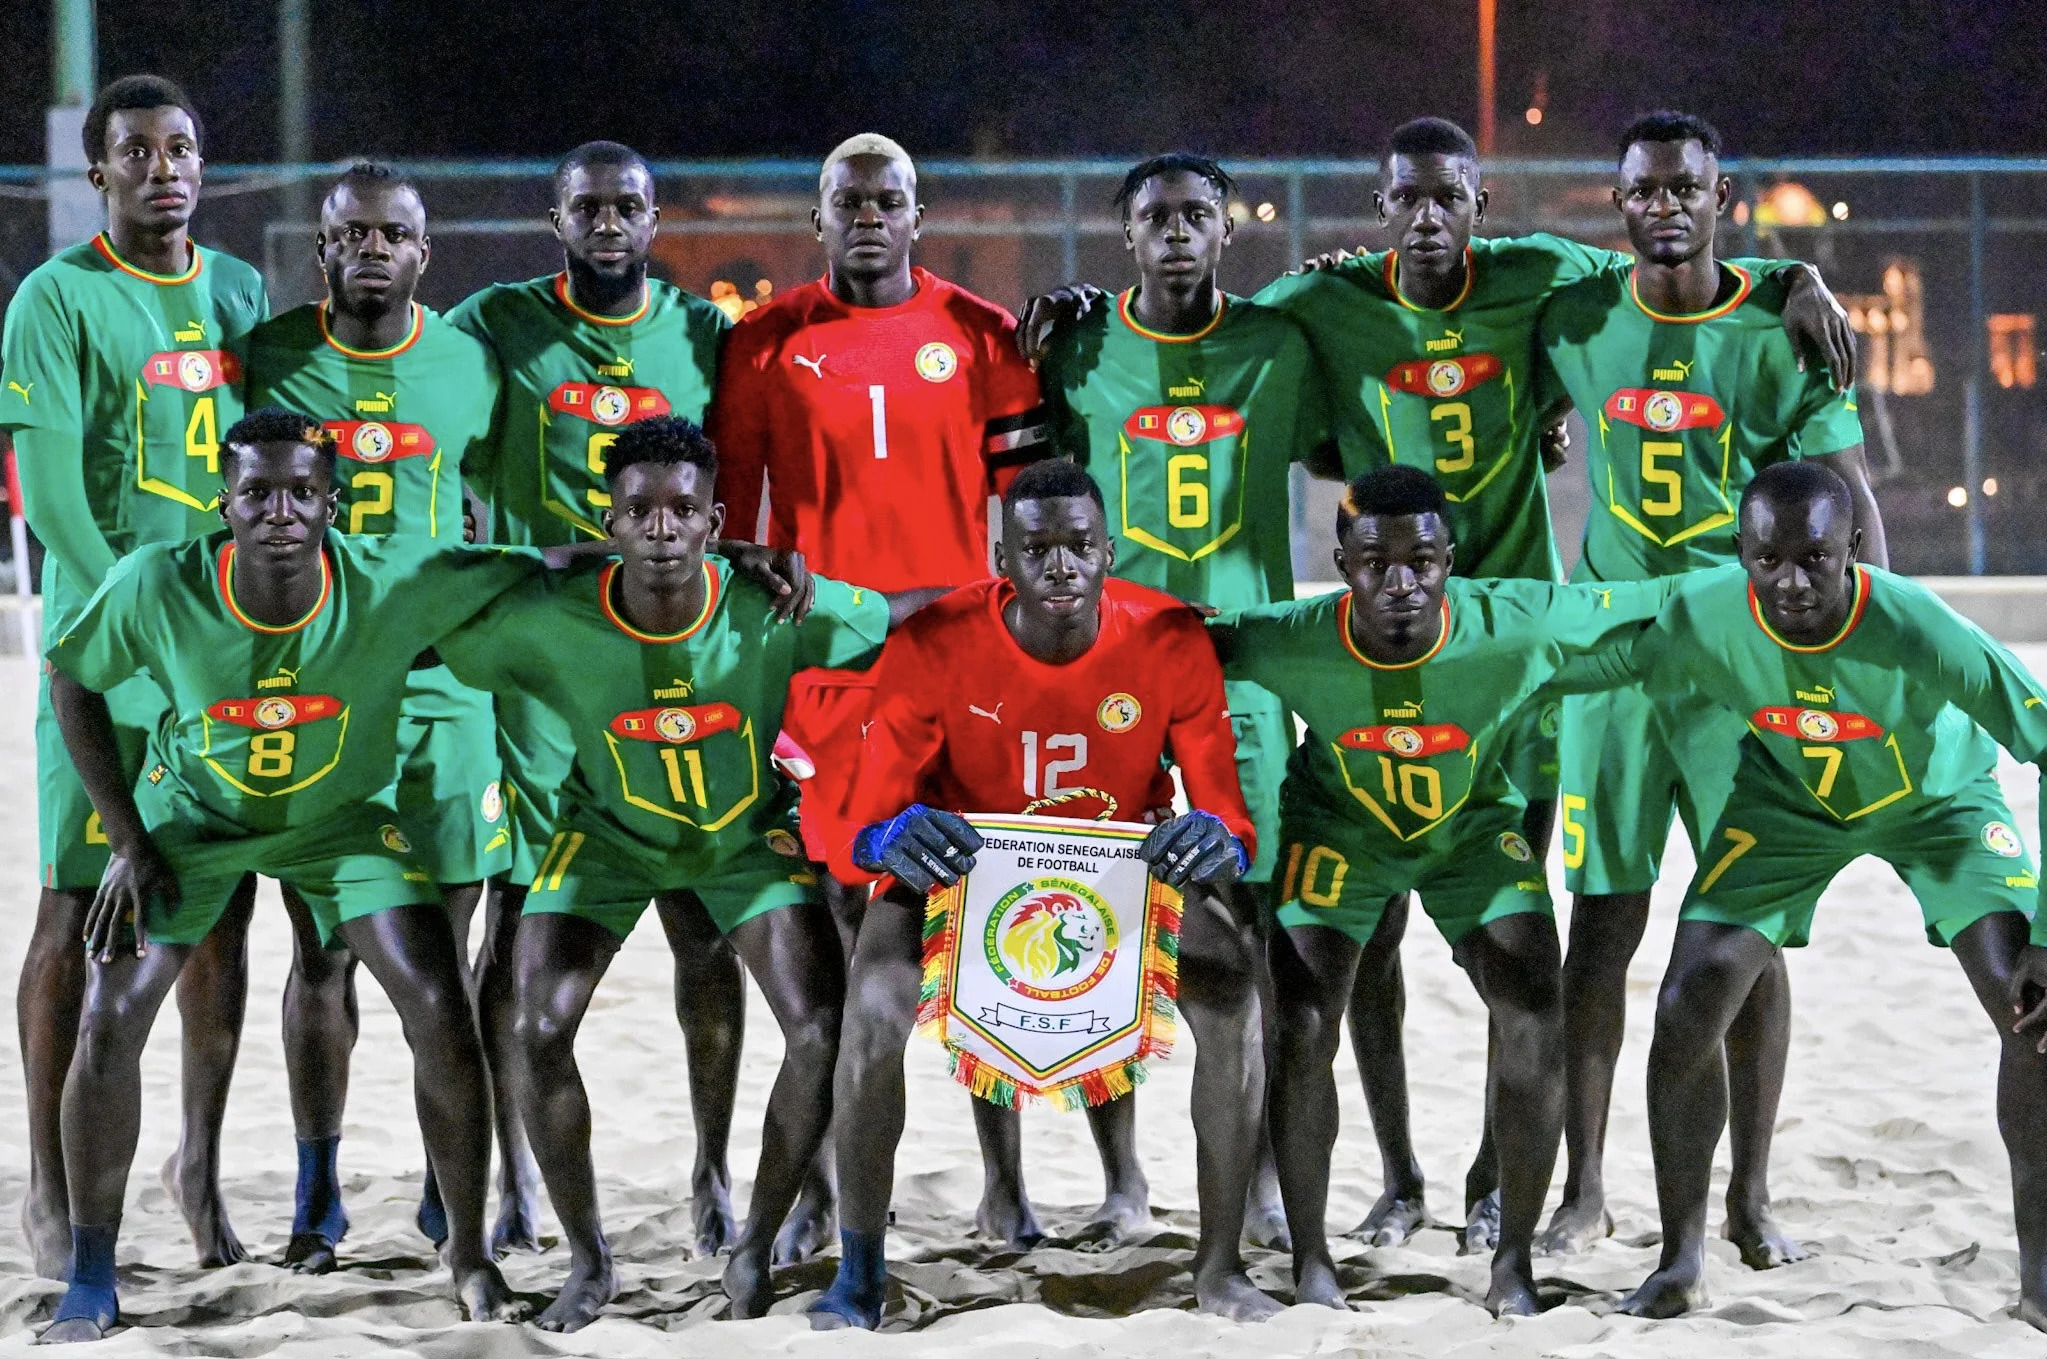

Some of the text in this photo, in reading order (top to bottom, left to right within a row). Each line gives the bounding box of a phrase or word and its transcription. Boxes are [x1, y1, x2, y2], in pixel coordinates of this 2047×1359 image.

[174, 329, 203, 342] PUMA
[1427, 338, 1458, 351] PUMA
[598, 364, 629, 377] PUMA
[1169, 386, 1201, 398] PUMA
[1653, 368, 1684, 381] PUMA
[356, 400, 389, 413] PUMA
[869, 385, 888, 459] 1
[186, 397, 220, 473] 4
[1432, 402, 1475, 473] 3
[349, 471, 394, 536] 2
[1168, 454, 1209, 528] 6
[1641, 441, 1683, 516] 5
[257, 676, 291, 690] PUMA
[653, 686, 688, 700] PUMA
[1796, 690, 1830, 703] PUMA
[1383, 708, 1417, 719] PUMA
[248, 730, 295, 778] 8
[659, 748, 707, 808] 11
[1021, 731, 1088, 801] 12
[1803, 746, 1843, 798] 7
[1377, 755, 1442, 821] 10
[1057, 843, 1141, 860] SENEGALAISE
[1562, 793, 1586, 869] 5
[530, 832, 585, 894] 11
[1017, 856, 1099, 874] DE FOOTBALL
[1282, 843, 1349, 908] 10
[1698, 827, 1757, 894] 7
[986, 878, 1116, 999] FÉDÉRATION SÉNÉGALAISE DE FOOTBALL
[1020, 1015, 1071, 1031] F.S.F
